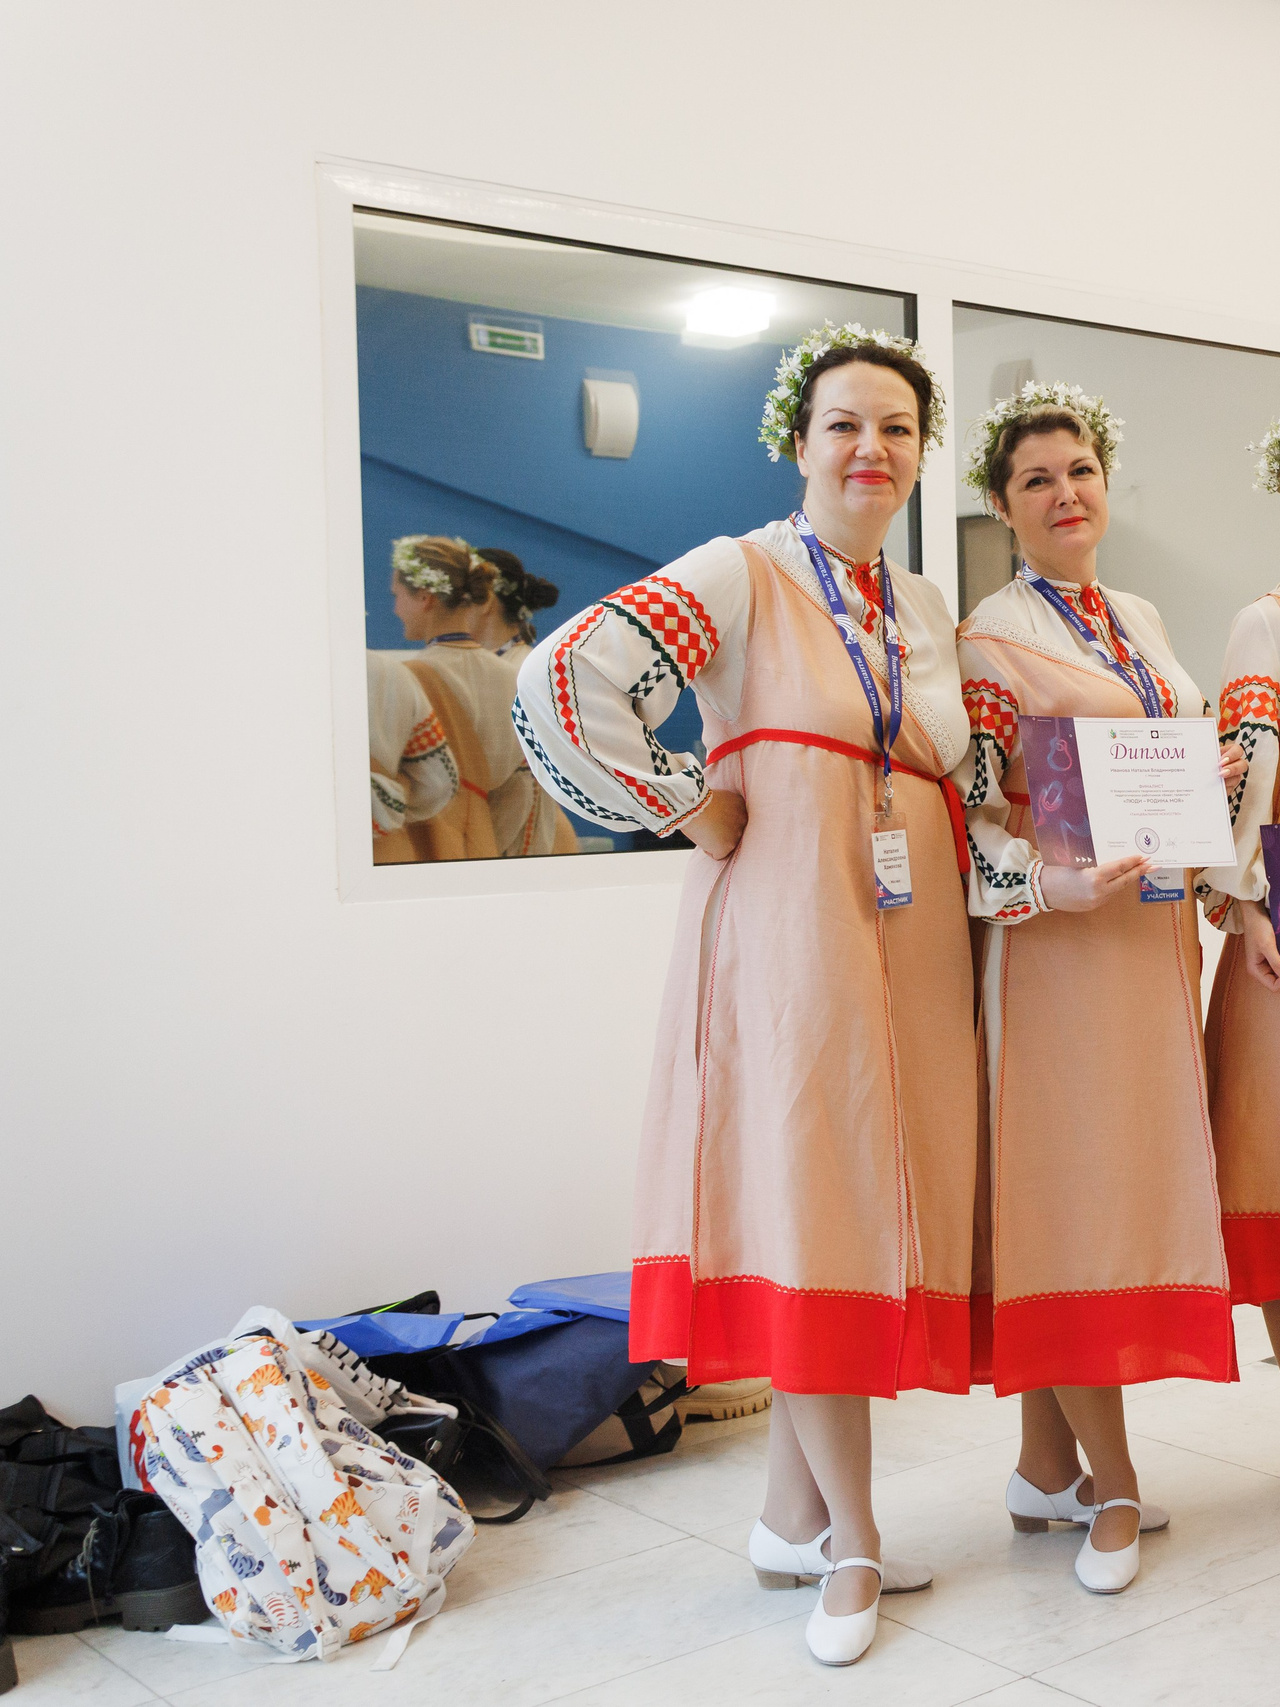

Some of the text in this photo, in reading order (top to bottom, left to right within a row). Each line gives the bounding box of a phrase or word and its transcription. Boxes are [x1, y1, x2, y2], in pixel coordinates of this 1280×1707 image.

[809, 546, 838, 603] Виват, таланты!
[853, 655, 872, 689] таланты!
[1110, 743, 1186, 760] Диплом
[883, 897, 909, 906] УЧАСТНИК
